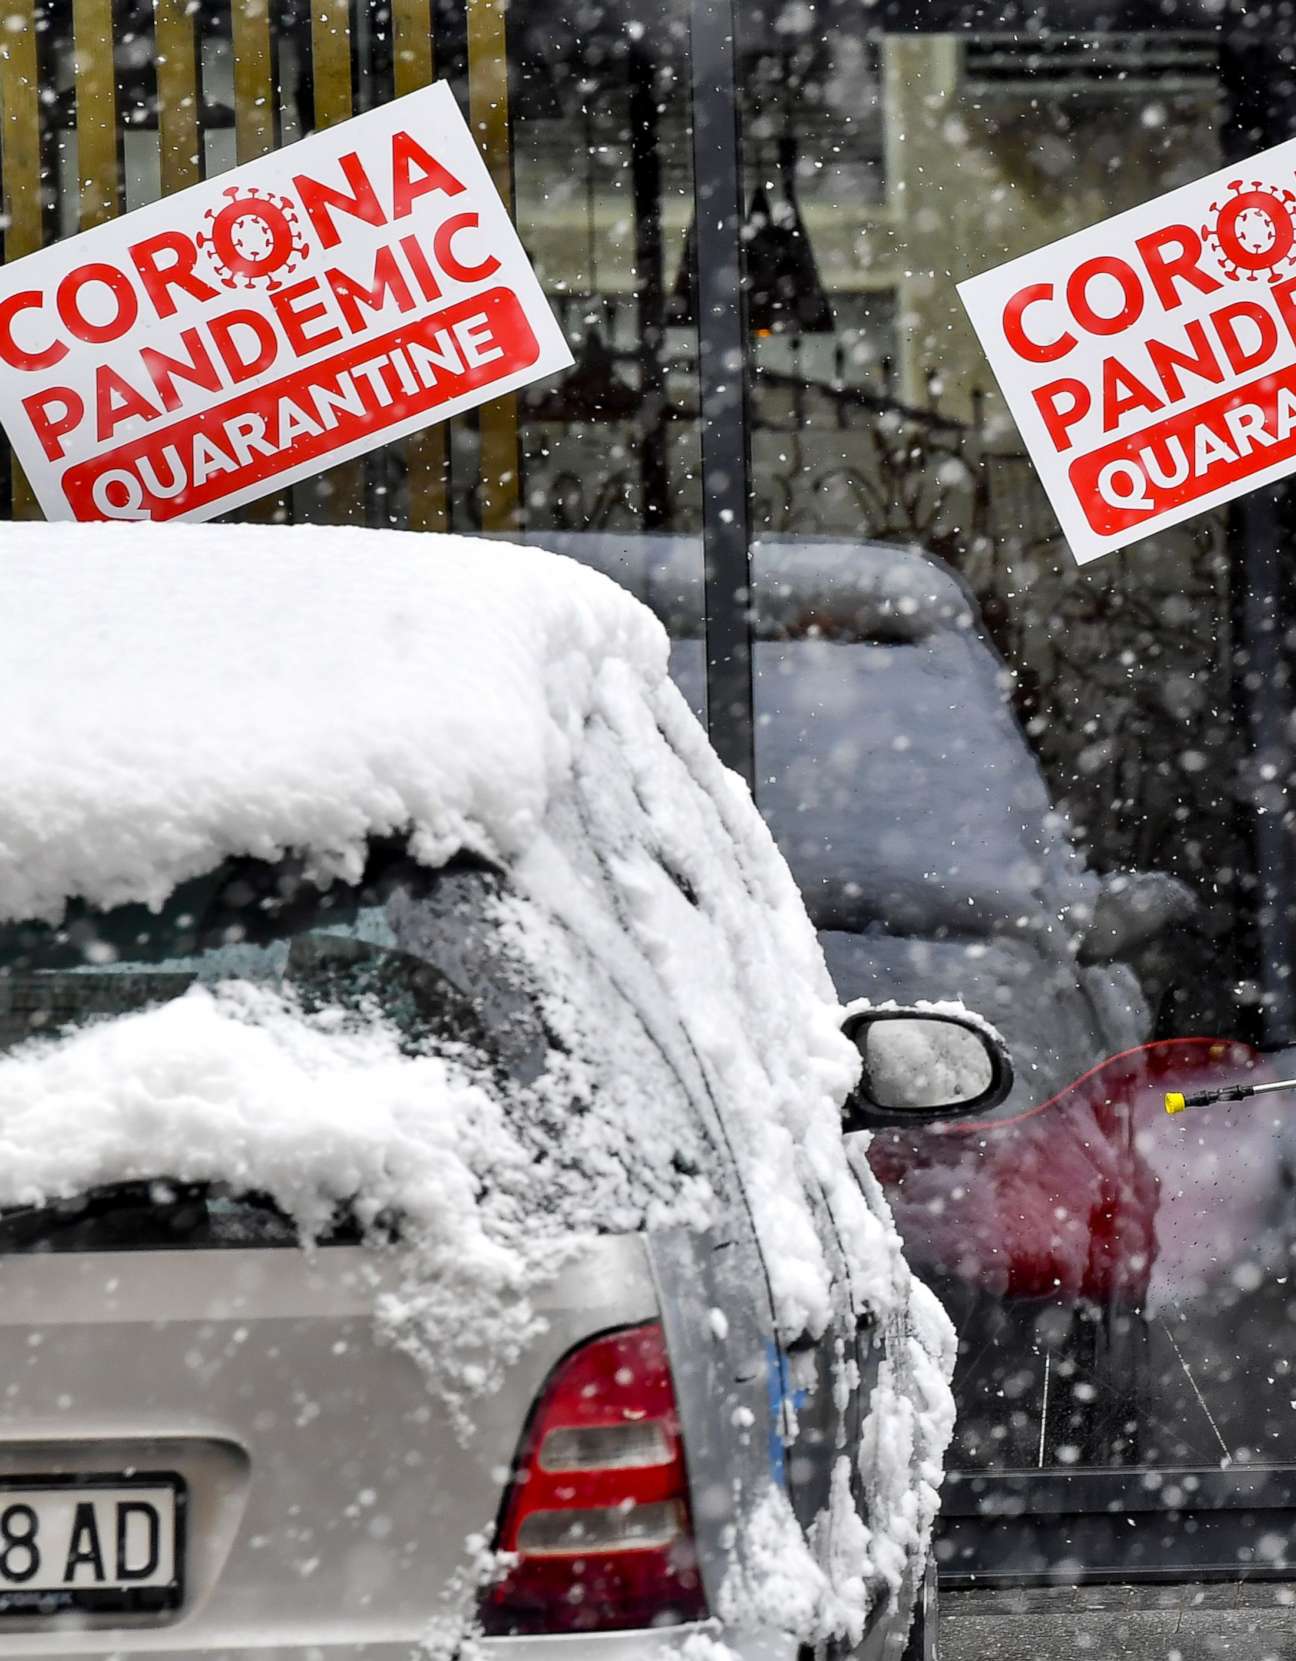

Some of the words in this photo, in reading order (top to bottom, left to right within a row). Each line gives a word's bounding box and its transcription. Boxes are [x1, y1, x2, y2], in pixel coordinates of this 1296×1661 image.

[0, 131, 467, 371] CORONA
[22, 212, 502, 462] PANDEMIC
[92, 311, 504, 520] QUARANTINE
[63, 1502, 159, 1582] AD
